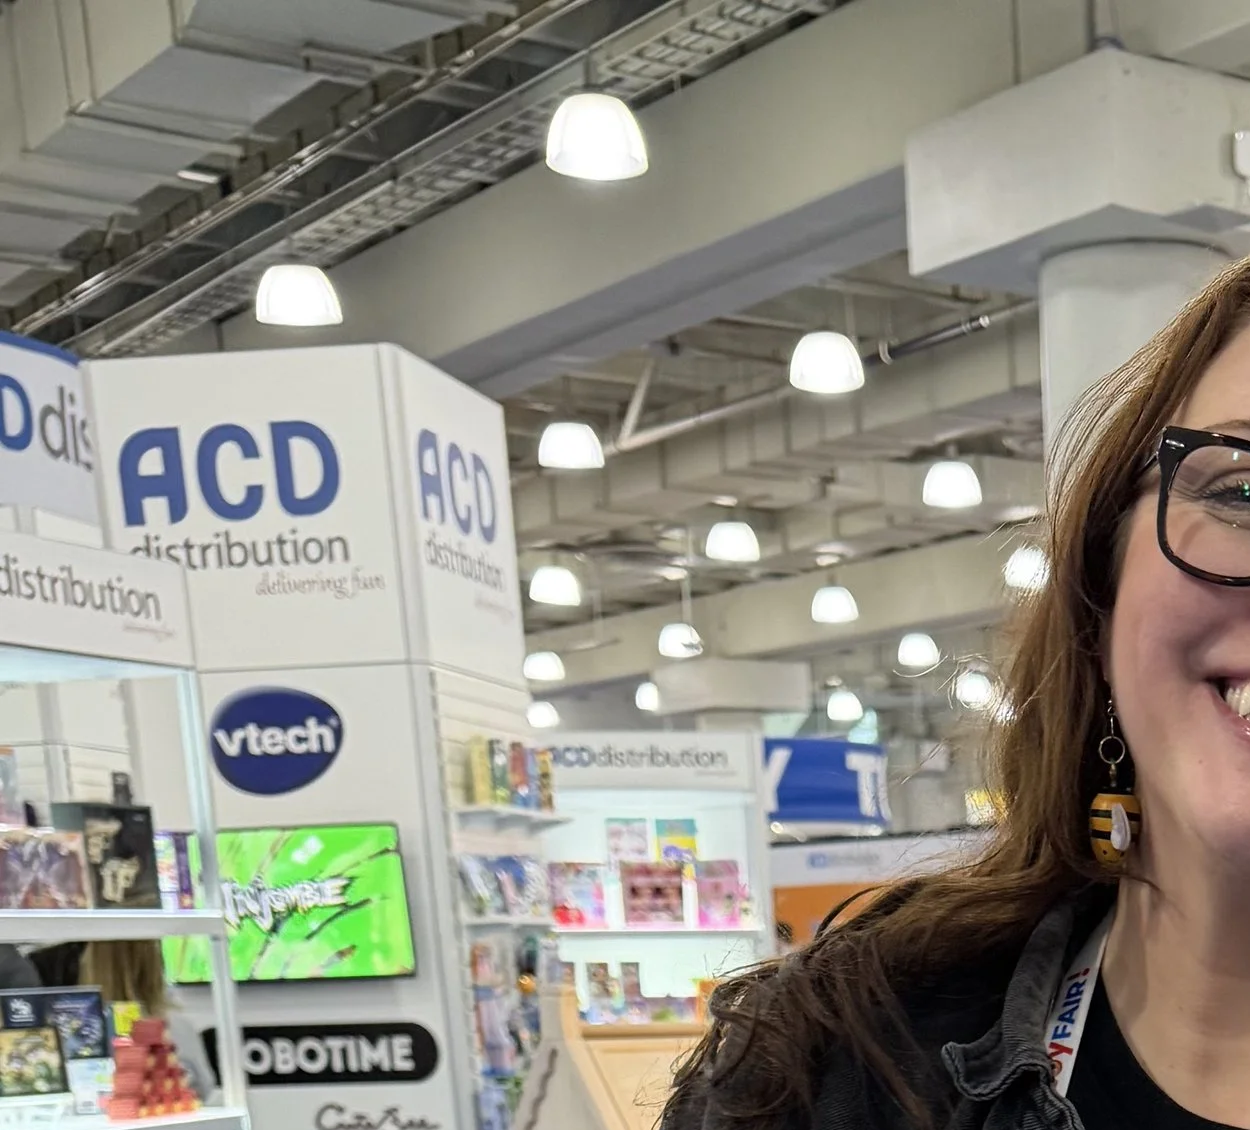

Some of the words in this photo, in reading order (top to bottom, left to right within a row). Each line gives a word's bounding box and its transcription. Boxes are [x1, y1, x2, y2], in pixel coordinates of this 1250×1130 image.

[118, 420, 340, 527] ACD
[417, 428, 496, 544] ACD
[0, 553, 162, 621] distribution
[213, 716, 336, 757] vtech
[597, 742, 728, 769] distribution
[243, 1033, 416, 1076] OBOTIME
